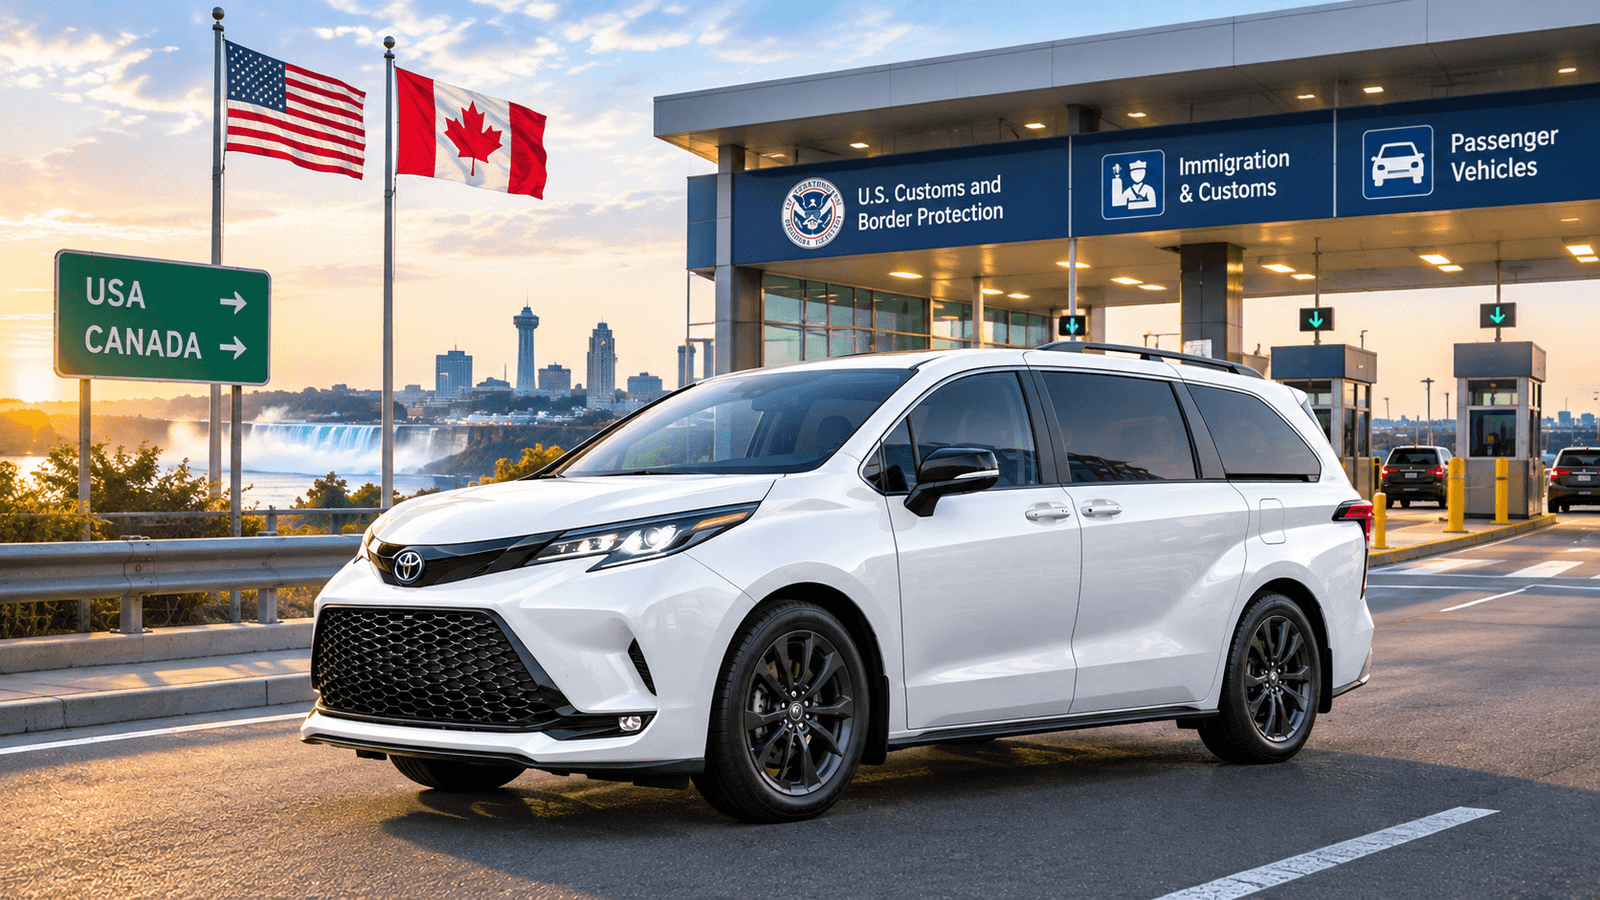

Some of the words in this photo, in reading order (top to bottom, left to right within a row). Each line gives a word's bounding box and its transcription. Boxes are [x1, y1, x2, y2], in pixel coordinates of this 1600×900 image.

[1451, 129, 1559, 154] Passenger
[1179, 149, 1290, 177] Immigration
[1450, 156, 1538, 182] Vehicles
[858, 185, 890, 206] U.S.
[894, 182, 966, 202] Customs
[970, 174, 1001, 196] and
[1179, 183, 1194, 203] &
[1198, 181, 1277, 202] Customs
[858, 209, 913, 231] Border
[917, 202, 1004, 226] Protection
[86, 276, 146, 309] USA
[84, 324, 202, 359] CANADA
